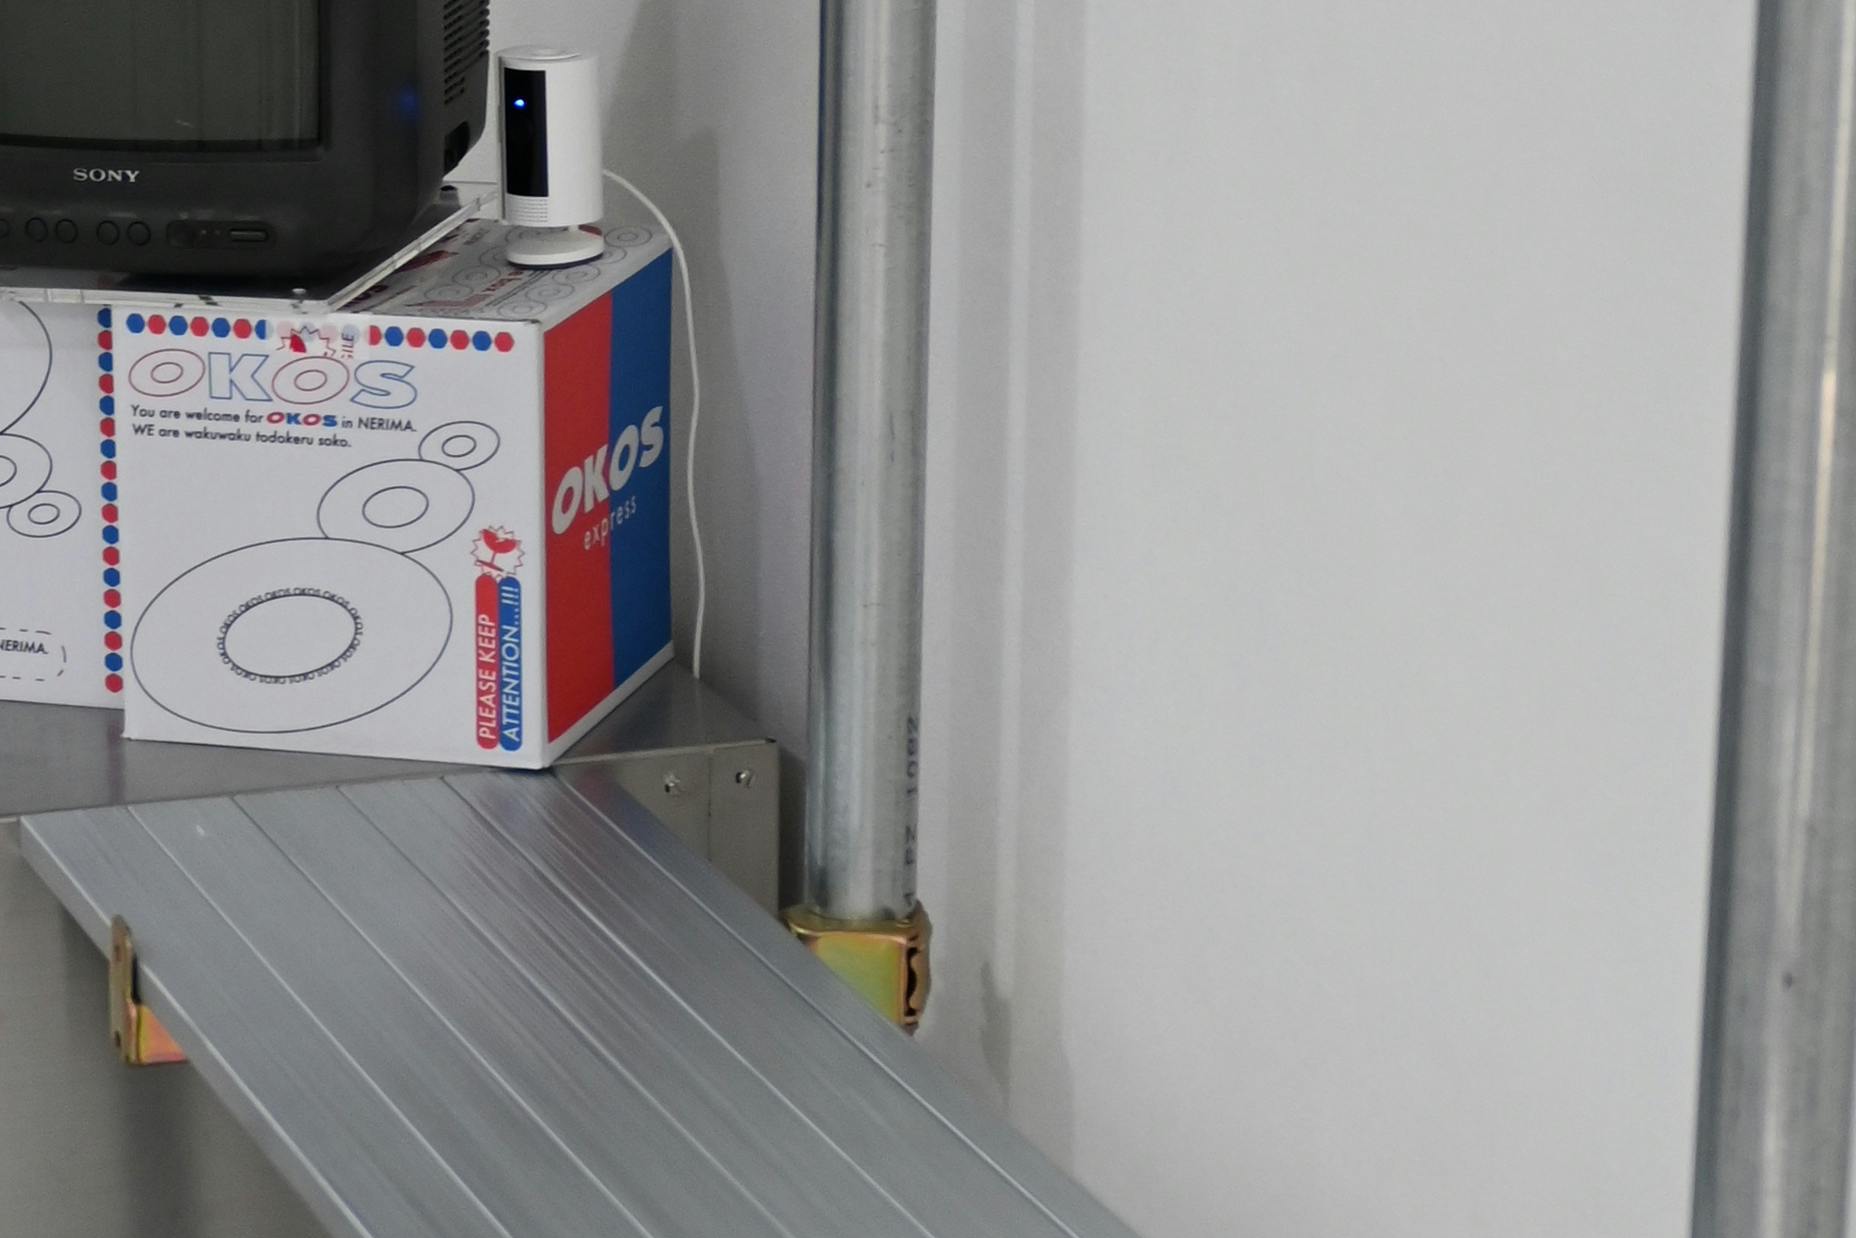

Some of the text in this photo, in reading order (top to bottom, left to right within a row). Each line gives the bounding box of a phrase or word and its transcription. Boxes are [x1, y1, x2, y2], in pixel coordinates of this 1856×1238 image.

[72, 167, 141, 183] SONY
[128, 348, 418, 409] OKOS
[130, 404, 417, 433] You are welcome for OKOS in NERIMA.
[133, 424, 155, 437] WE
[158, 427, 180, 438] are
[184, 426, 251, 442] wakuwaku
[255, 430, 314, 446] todokeru
[551, 405, 665, 535] OKOS
[583, 495, 637, 551] express
[477, 613, 497, 740] PLEASE KEEP
[500, 585, 521, 742] ATTENTION...!!!
